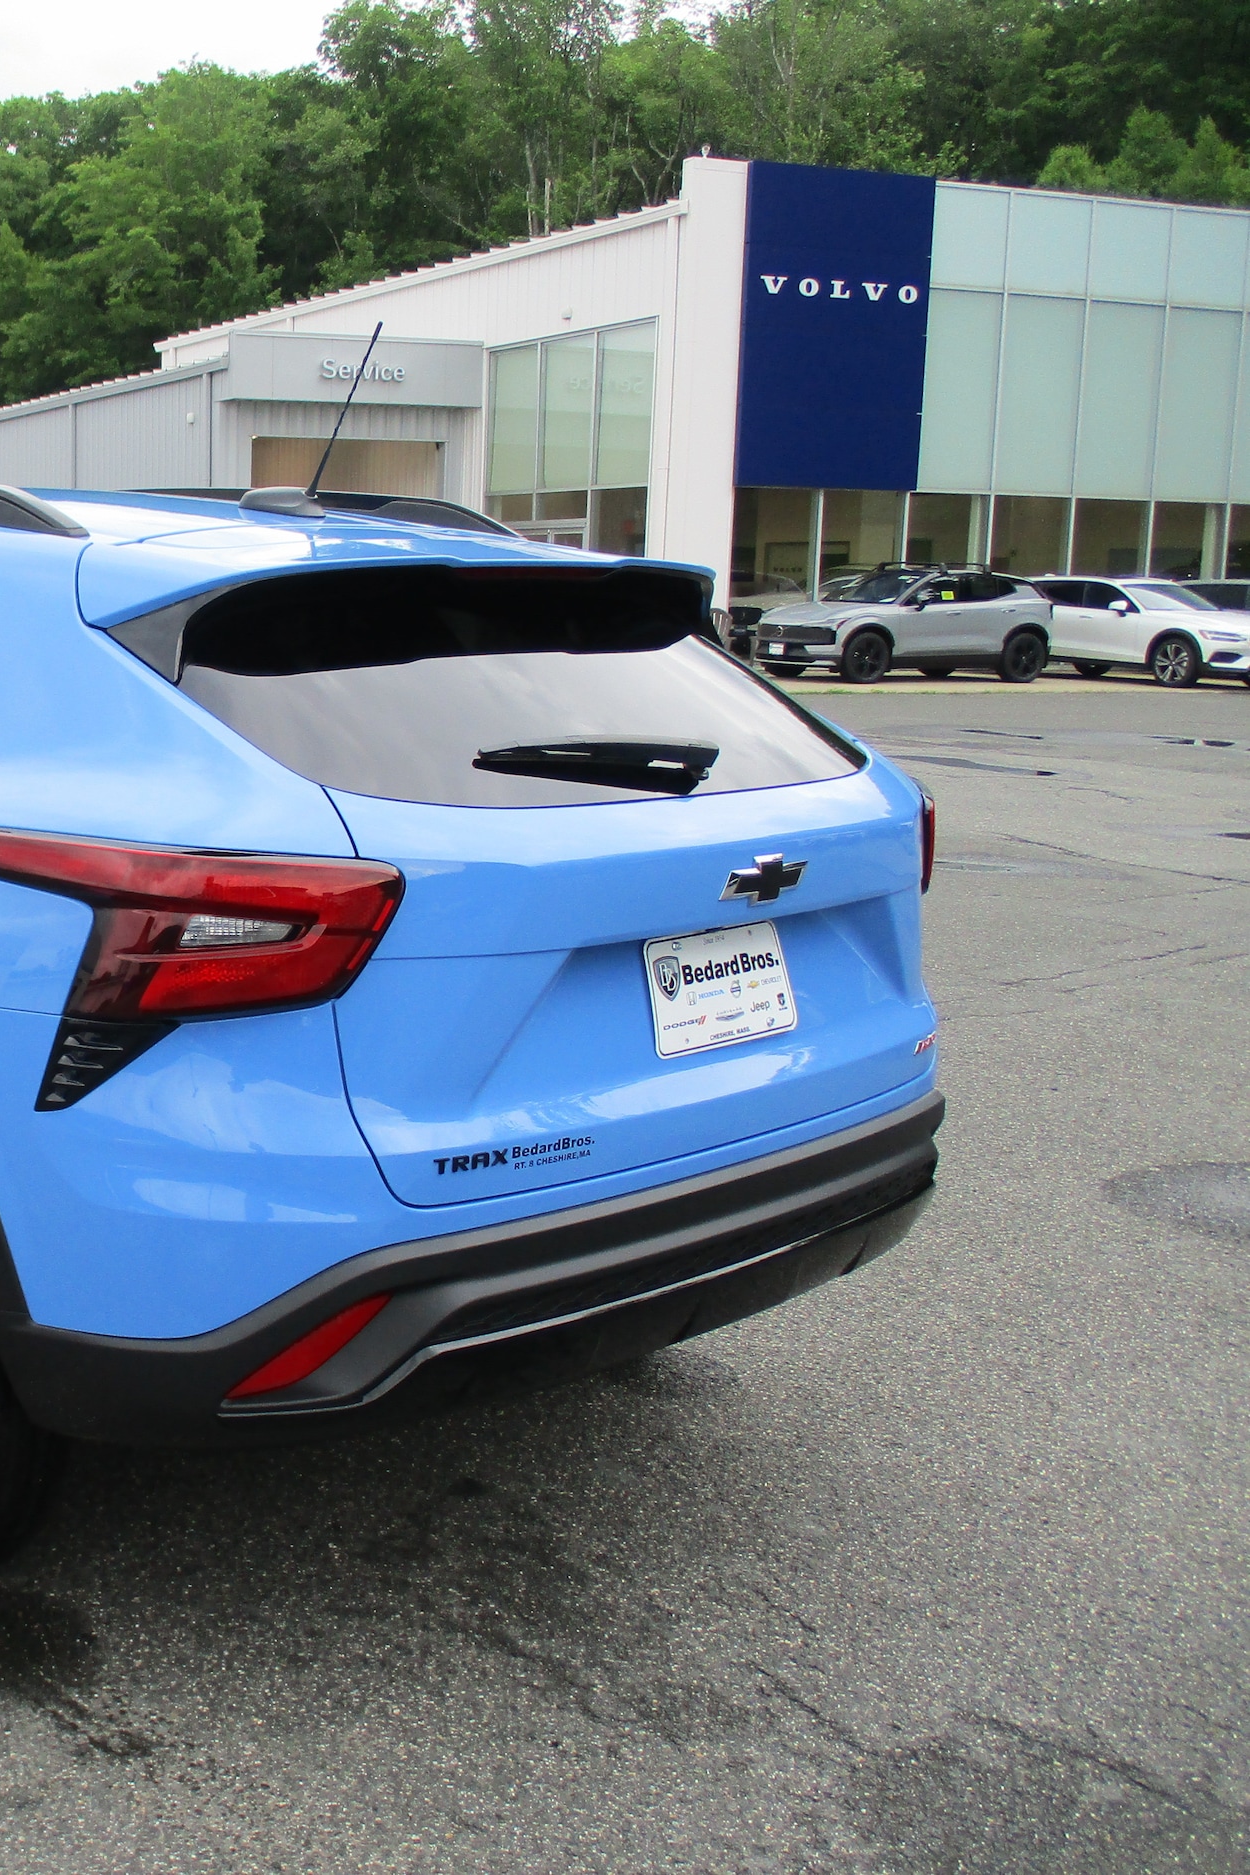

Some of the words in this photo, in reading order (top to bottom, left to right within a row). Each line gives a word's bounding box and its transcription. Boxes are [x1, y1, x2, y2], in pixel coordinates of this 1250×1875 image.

[759, 274, 919, 304] VOLVO
[321, 358, 406, 382] Service
[698, 989, 725, 999] HONDA
[750, 1000, 770, 1013] Jeep
[433, 1148, 509, 1175] TRAX
[514, 1161, 527, 1170] RT.
[529, 1160, 534, 1168] 8
